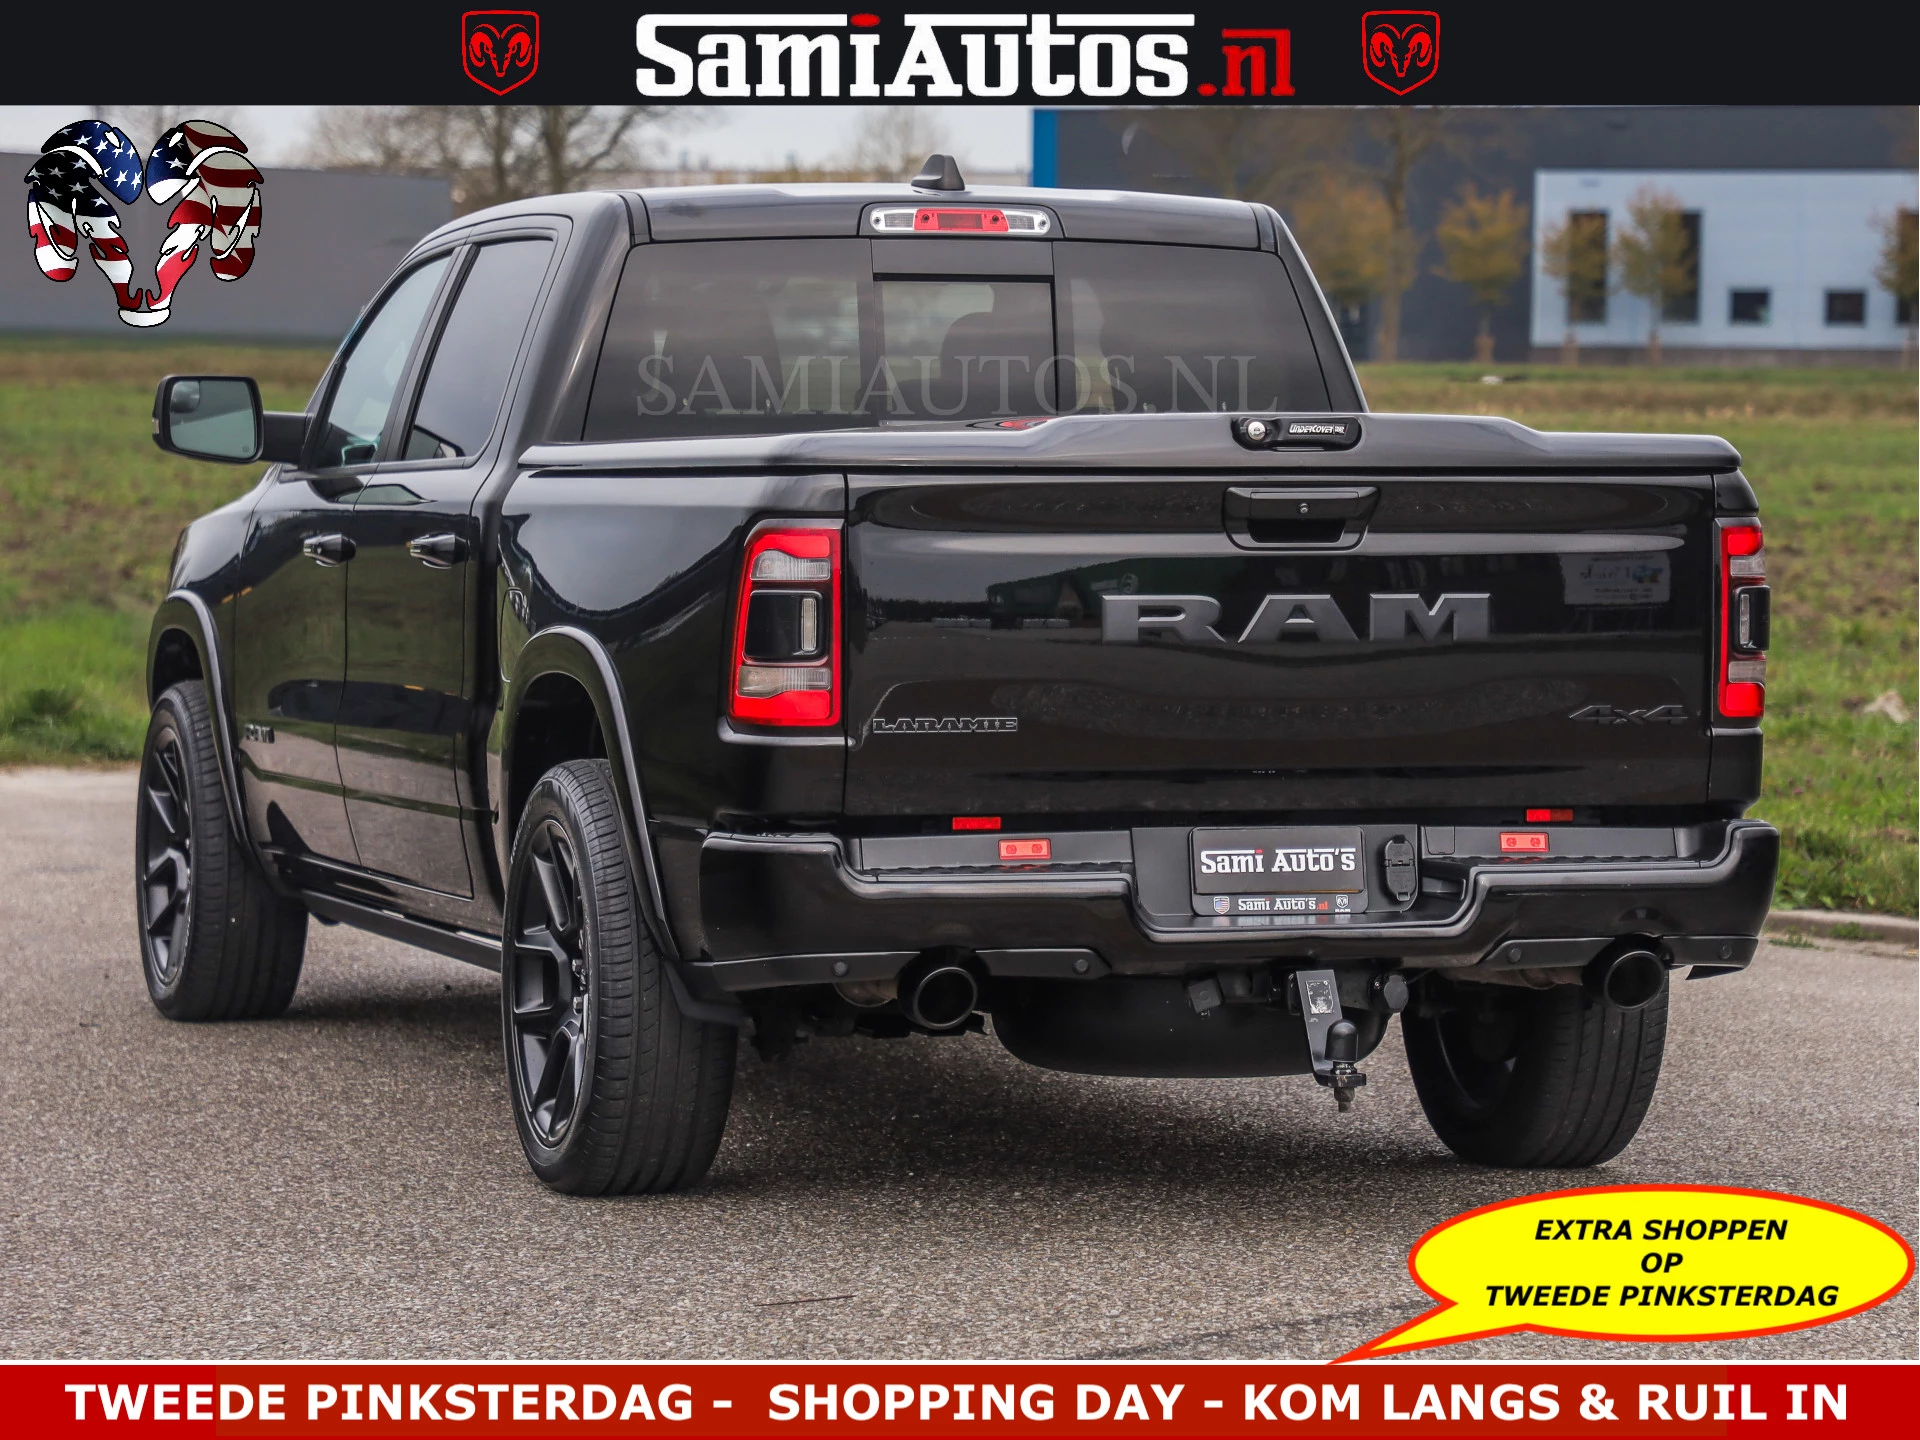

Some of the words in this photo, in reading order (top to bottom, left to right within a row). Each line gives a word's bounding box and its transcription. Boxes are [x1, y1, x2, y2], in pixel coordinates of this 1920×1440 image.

[1102, 593, 1491, 643] RAM
[872, 717, 1018, 733] LARAMIE
[1200, 849, 1264, 874] Sami
[1271, 847, 1357, 873] Auto's
[1237, 898, 1271, 911] Sami
